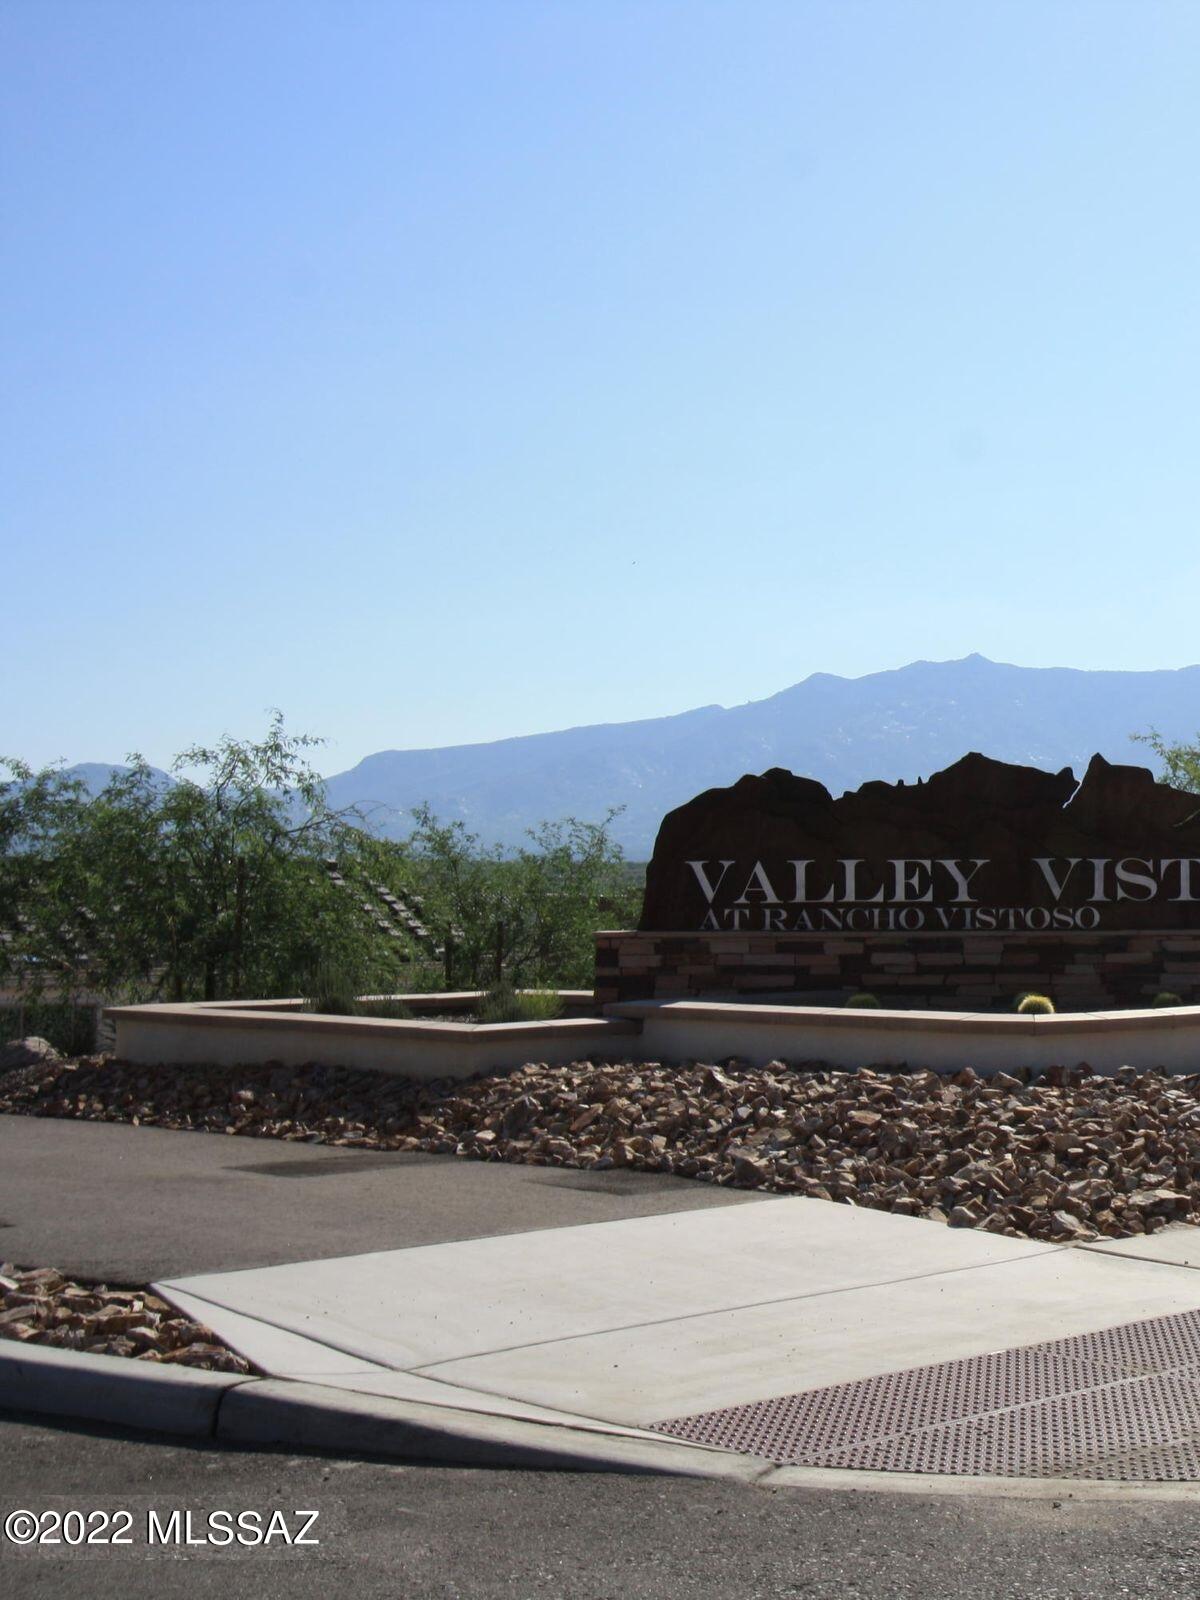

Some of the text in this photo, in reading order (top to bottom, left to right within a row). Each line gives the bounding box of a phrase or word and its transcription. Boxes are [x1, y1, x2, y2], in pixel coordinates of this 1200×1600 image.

[685, 858, 991, 904] VALLEY
[701, 906, 1101, 931] AT RANCHO VISTOSO
